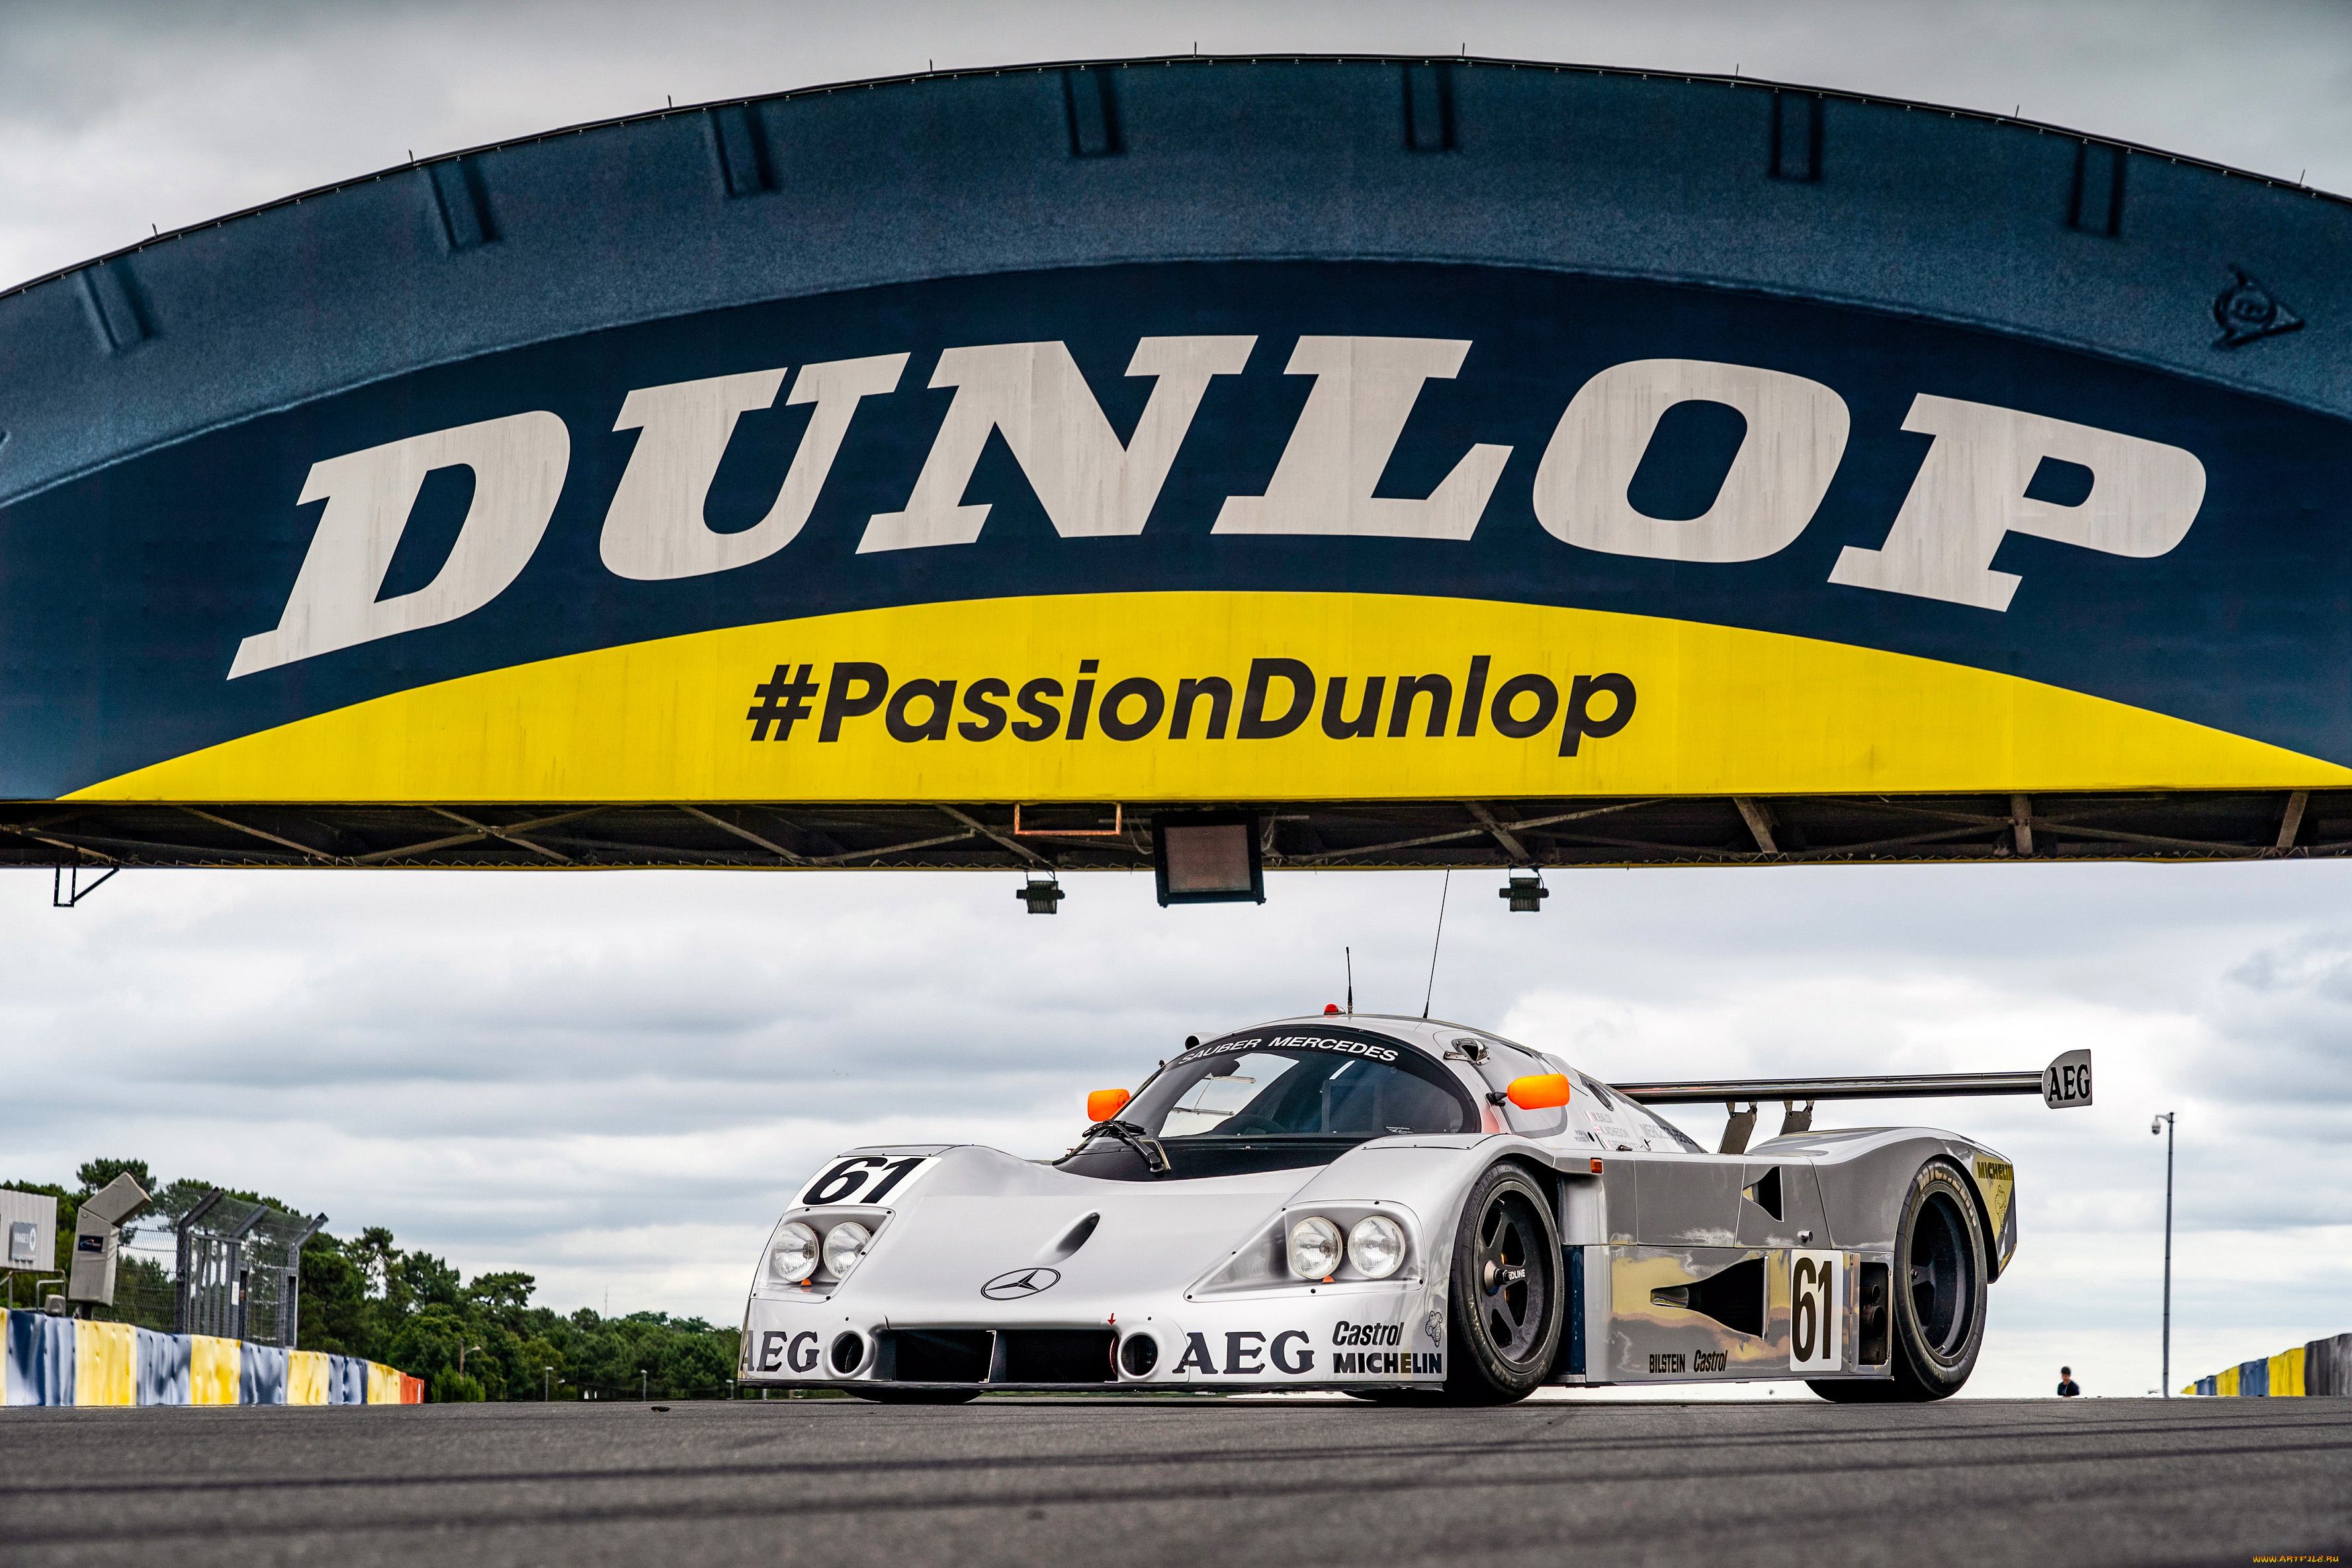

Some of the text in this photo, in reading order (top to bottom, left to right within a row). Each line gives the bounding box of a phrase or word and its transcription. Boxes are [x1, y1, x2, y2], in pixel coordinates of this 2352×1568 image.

[227, 335, 2206, 680] DUNLOP
[746, 656, 1636, 757] #PassionDunlop
[1178, 1037, 1399, 1064] SAUBER MERCEDES
[2048, 1064, 2090, 1102] AEG
[803, 1156, 927, 1205] 61
[1976, 1162, 2013, 1181] MICHELIN
[1792, 1257, 1832, 1362] 61
[1172, 1330, 1315, 1374] AEG
[1332, 1321, 1404, 1346] Castrol
[1332, 1352, 1442, 1373] MICHELIN
[1649, 1350, 1728, 1373] BILSTEIN Castrol
